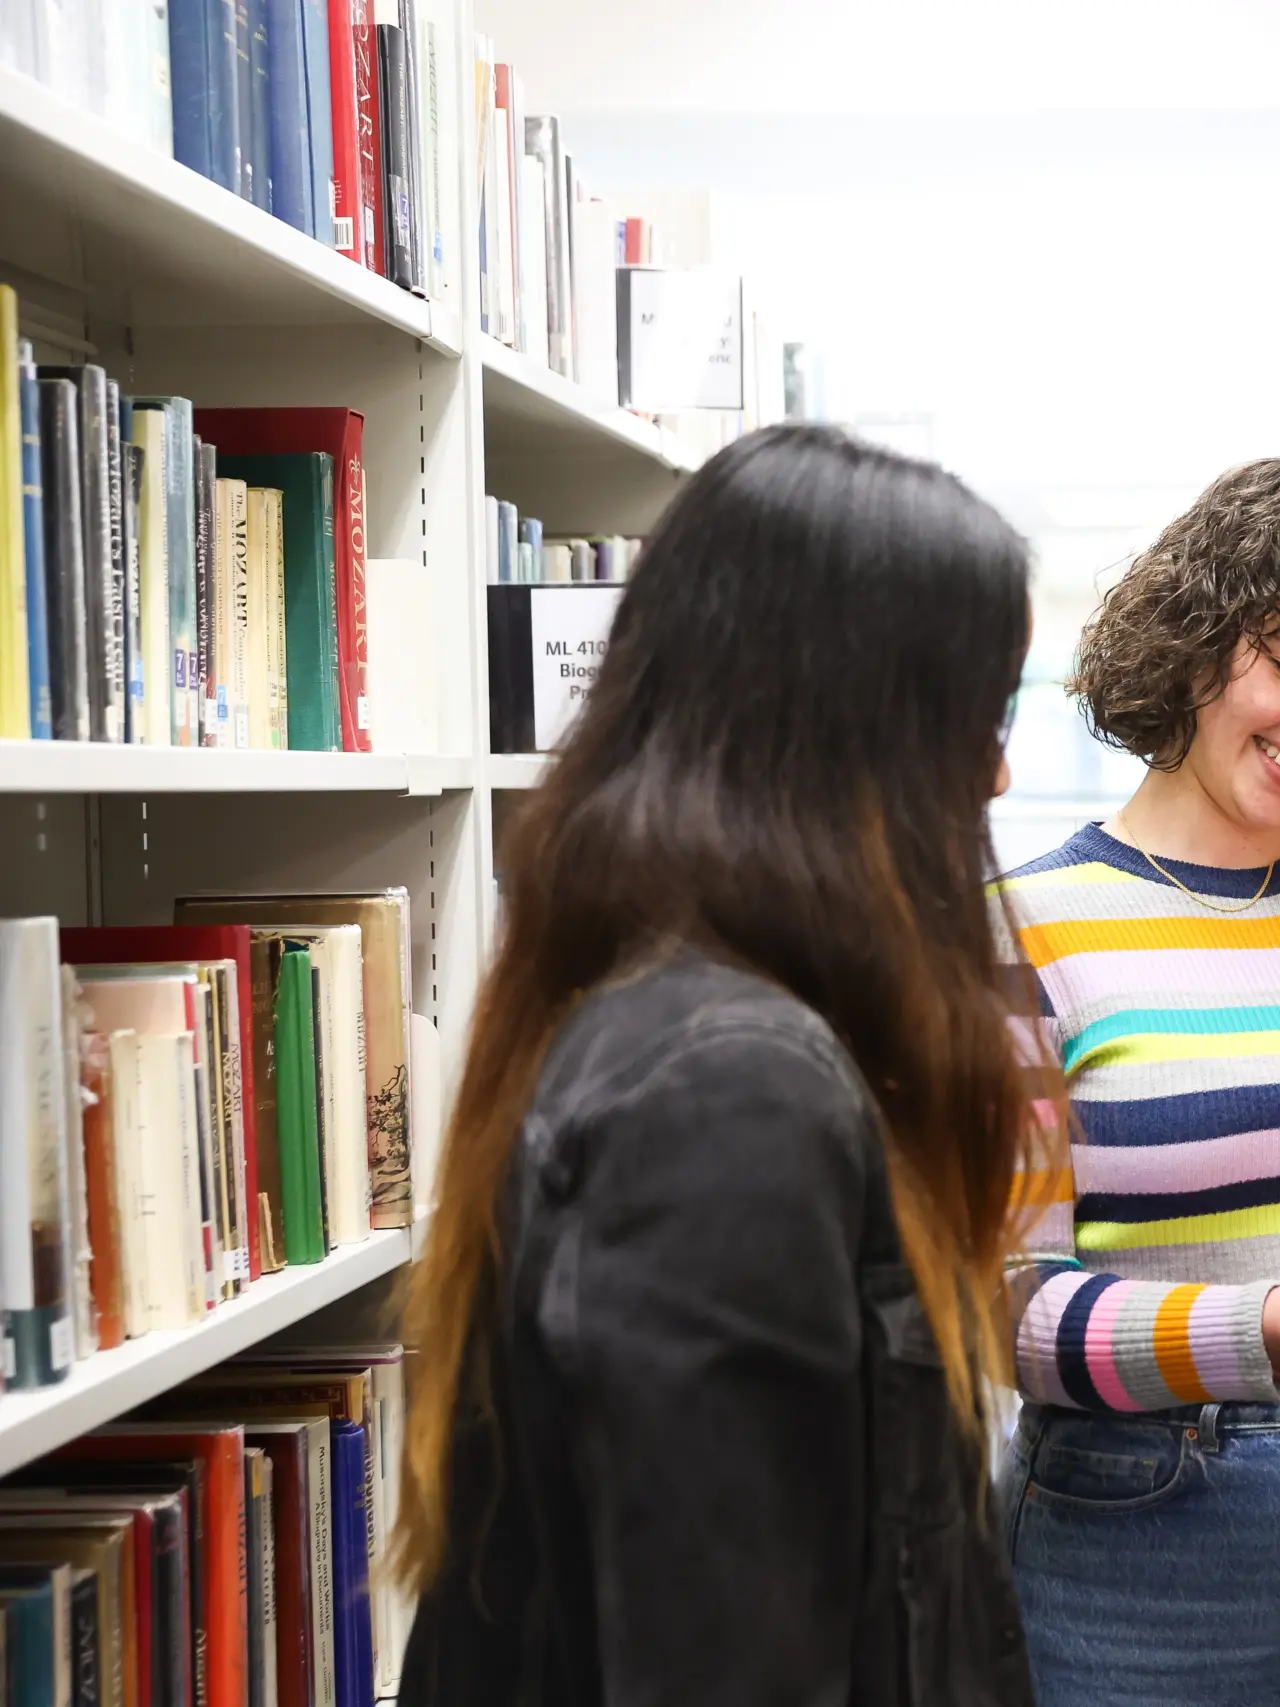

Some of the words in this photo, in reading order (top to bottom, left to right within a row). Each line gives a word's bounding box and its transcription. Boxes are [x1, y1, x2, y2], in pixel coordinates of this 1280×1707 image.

[109, 450, 122, 560] Mozart's
[127, 537, 139, 619] MOZART
[235, 519, 247, 628] MOZART
[328, 560, 338, 630] MOZART
[349, 484, 368, 674] MOZART
[546, 641, 572, 656] ML
[560, 663, 601, 681] Biog
[569, 685, 588, 701] Pr
[356, 1011, 366, 1073] MOZART
[222, 1051, 233, 1123] MOZART
[230, 1042, 242, 1114] MOZART
[211, 1102, 222, 1170] MOZART
[314, 1502, 321, 1510] A
[318, 1445, 328, 1526] Musorgsky's
[314, 1511, 322, 1561] Biography
[320, 1528, 329, 1561] Days
[315, 1563, 322, 1573] in
[316, 1574, 325, 1635] Documents
[324, 1588, 332, 1631] Works
